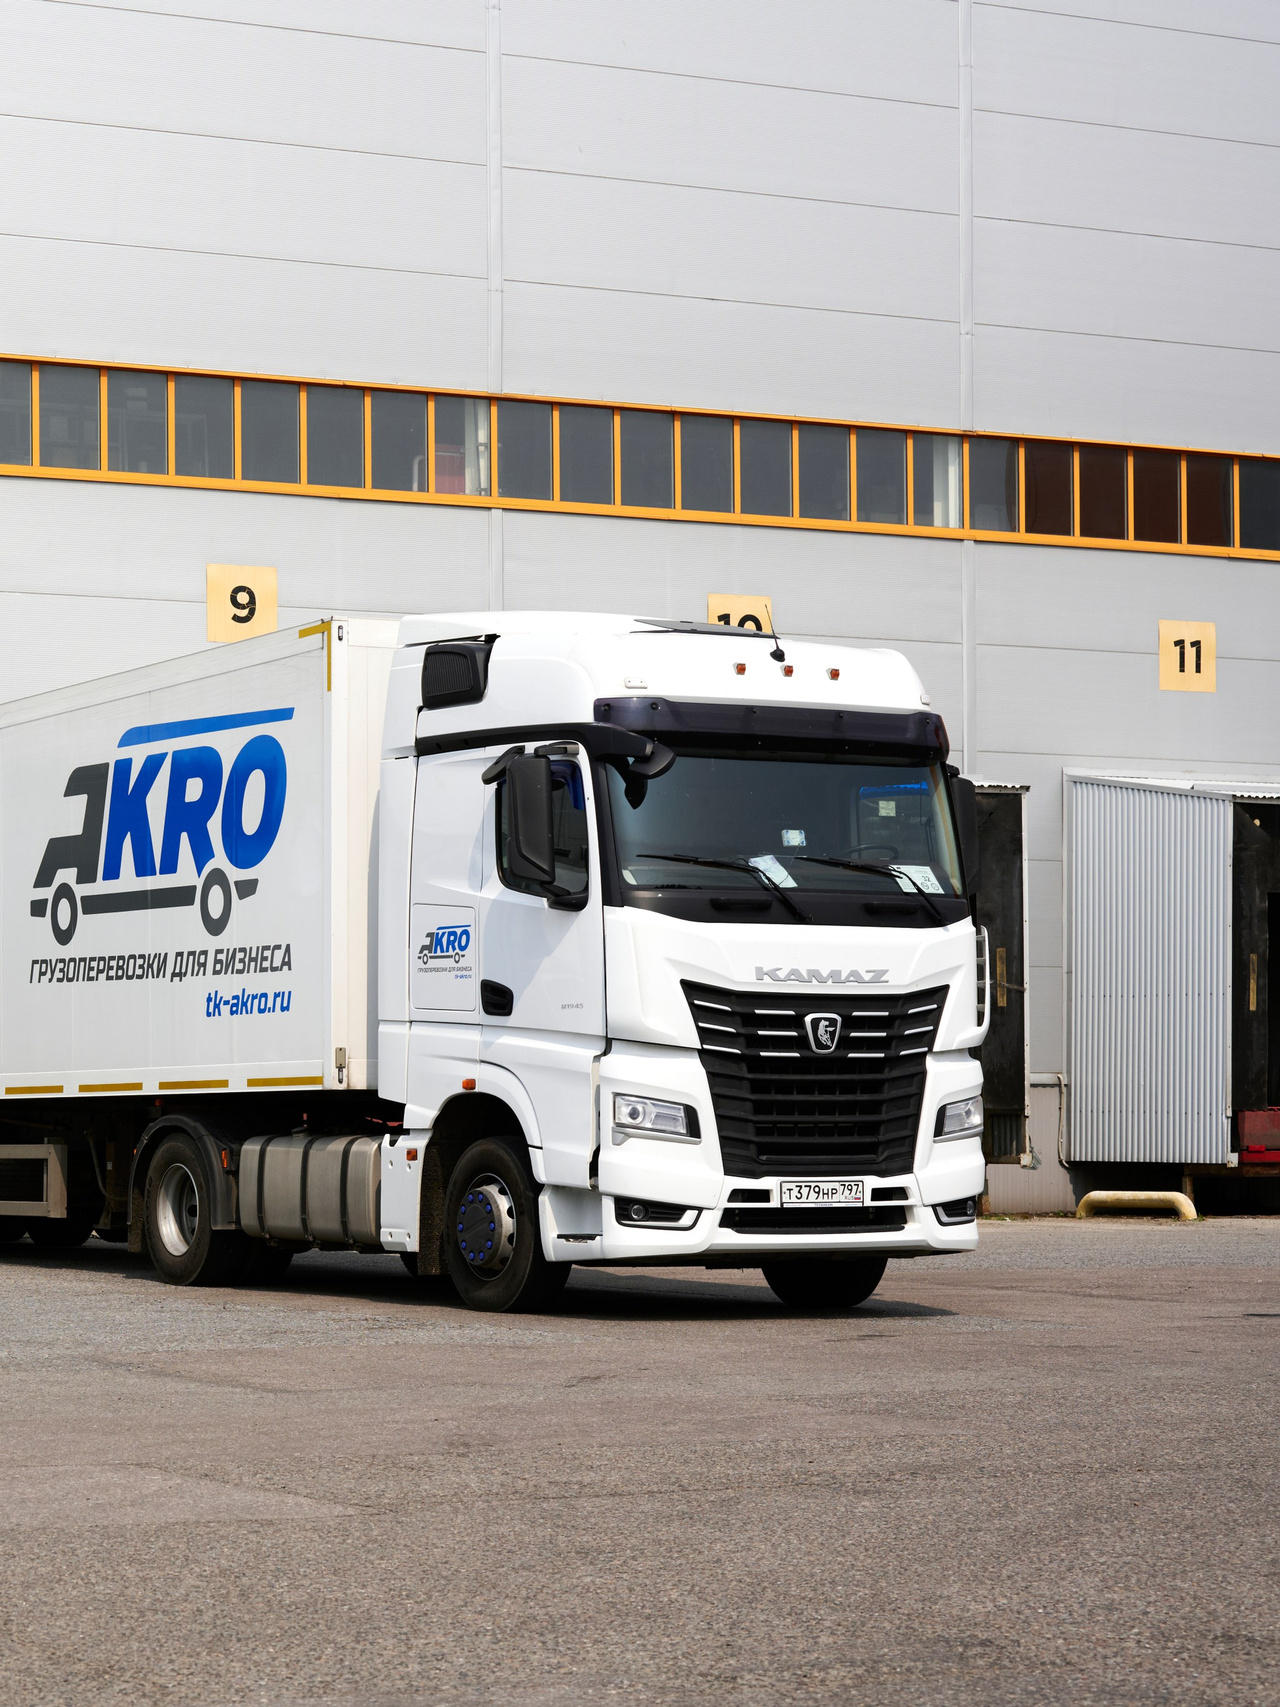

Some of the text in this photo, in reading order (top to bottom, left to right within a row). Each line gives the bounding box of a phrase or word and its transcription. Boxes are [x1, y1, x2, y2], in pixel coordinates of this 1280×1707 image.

[229, 585, 257, 624] 9
[1173, 638, 1202, 674] 11
[32, 734, 288, 889] AKRO
[418, 928, 471, 955] AKRO
[29, 943, 293, 984] ГРУЗОПЕРЕВОЗКИ ДЛЯ БИЗНЕСА
[754, 965, 890, 984] KAMAZ
[206, 987, 293, 1019] tk-akro.ru
[840, 1183, 860, 1196] 797
